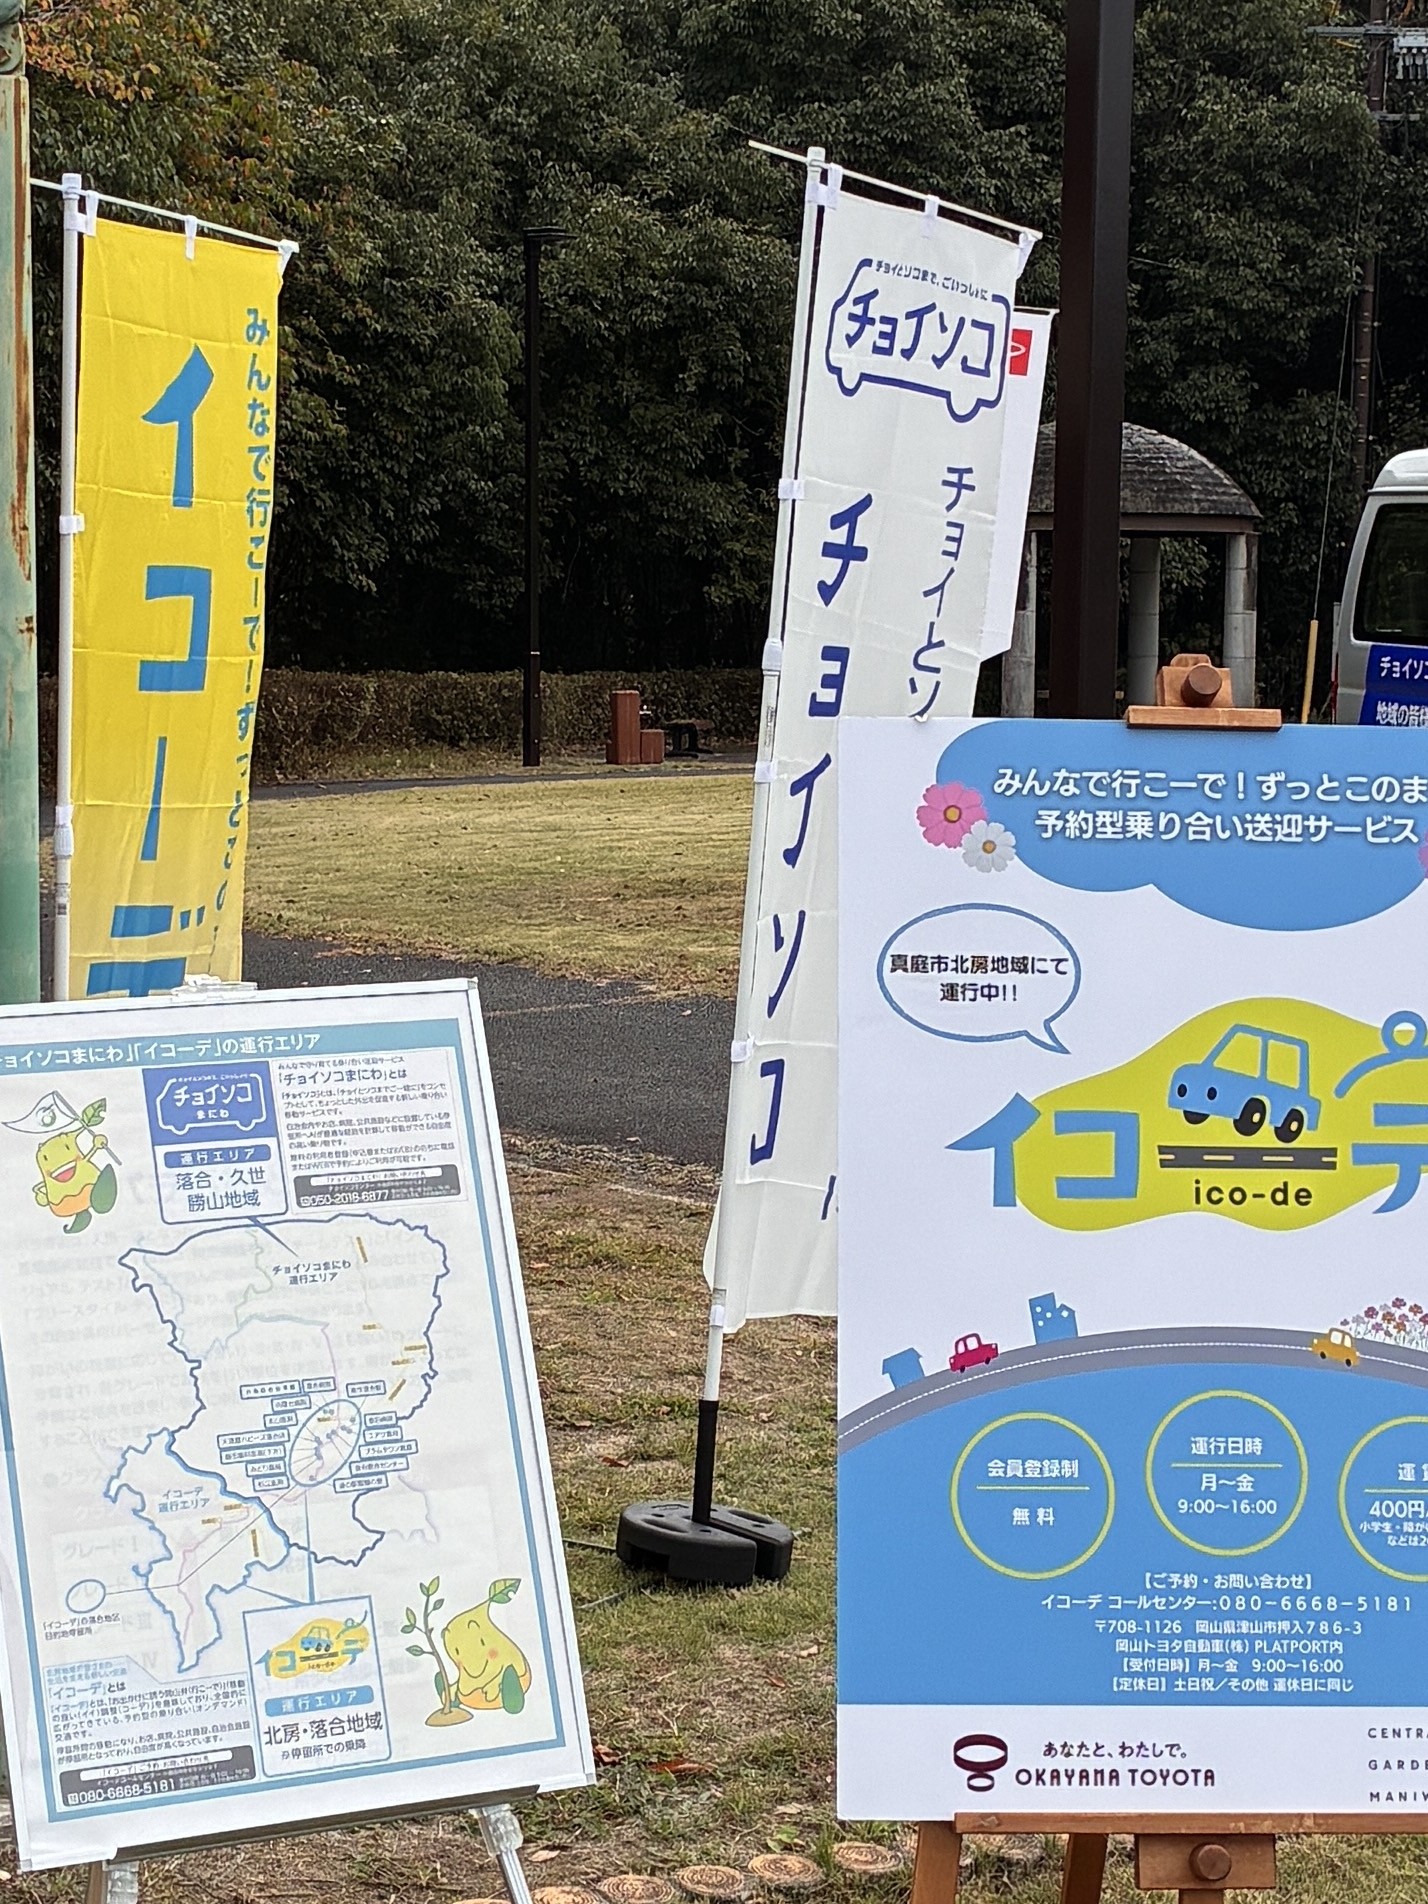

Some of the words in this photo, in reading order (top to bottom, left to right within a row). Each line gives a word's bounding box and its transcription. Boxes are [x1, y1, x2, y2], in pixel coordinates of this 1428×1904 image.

[844, 288, 995, 378] チョイソコ
[88, 344, 215, 997] イコーデ
[750, 492, 874, 1166] チョイソコ
[1034, 809, 1421, 846] 予約型乗り合い送迎サービス
[889, 954, 1070, 977] 真庭市北房地域にて
[174, 1083, 253, 1107] チョイソコ
[196, 1109, 229, 1120] まにわ
[180, 1148, 254, 1165] 運行エリア
[176, 1166, 266, 1191] 落合・久世
[188, 1189, 262, 1213] 勝山地域
[1193, 1179, 1314, 1208] ico-de
[272, 1260, 352, 1276] チョイソコまにわ
[288, 1271, 339, 1285] 運行エリア
[1190, 1436, 1264, 1456] 運行日時
[987, 1459, 1079, 1479] 会員登録制
[162, 1486, 204, 1500] イコーデ
[158, 1497, 210, 1513] 運行エリア
[1144, 1573, 1313, 1590] 【ご予約・お問い合わせ】
[1041, 1595, 1102, 1612] イコーデ
[1254, 1638, 1344, 1655] PLATPORT内
[49, 1680, 127, 1700] 「イコーデ」とは
[1273, 1677, 1355, 1693] 運休日に同じ
[281, 1690, 358, 1713] 運行エリア
[263, 1711, 384, 1747] 北房・落合地域
[1043, 1741, 1187, 1758] あなたと、わたしで。
[1015, 1768, 1120, 1786] OKAYAMA
[1128, 1769, 1215, 1787] TOYOTA
